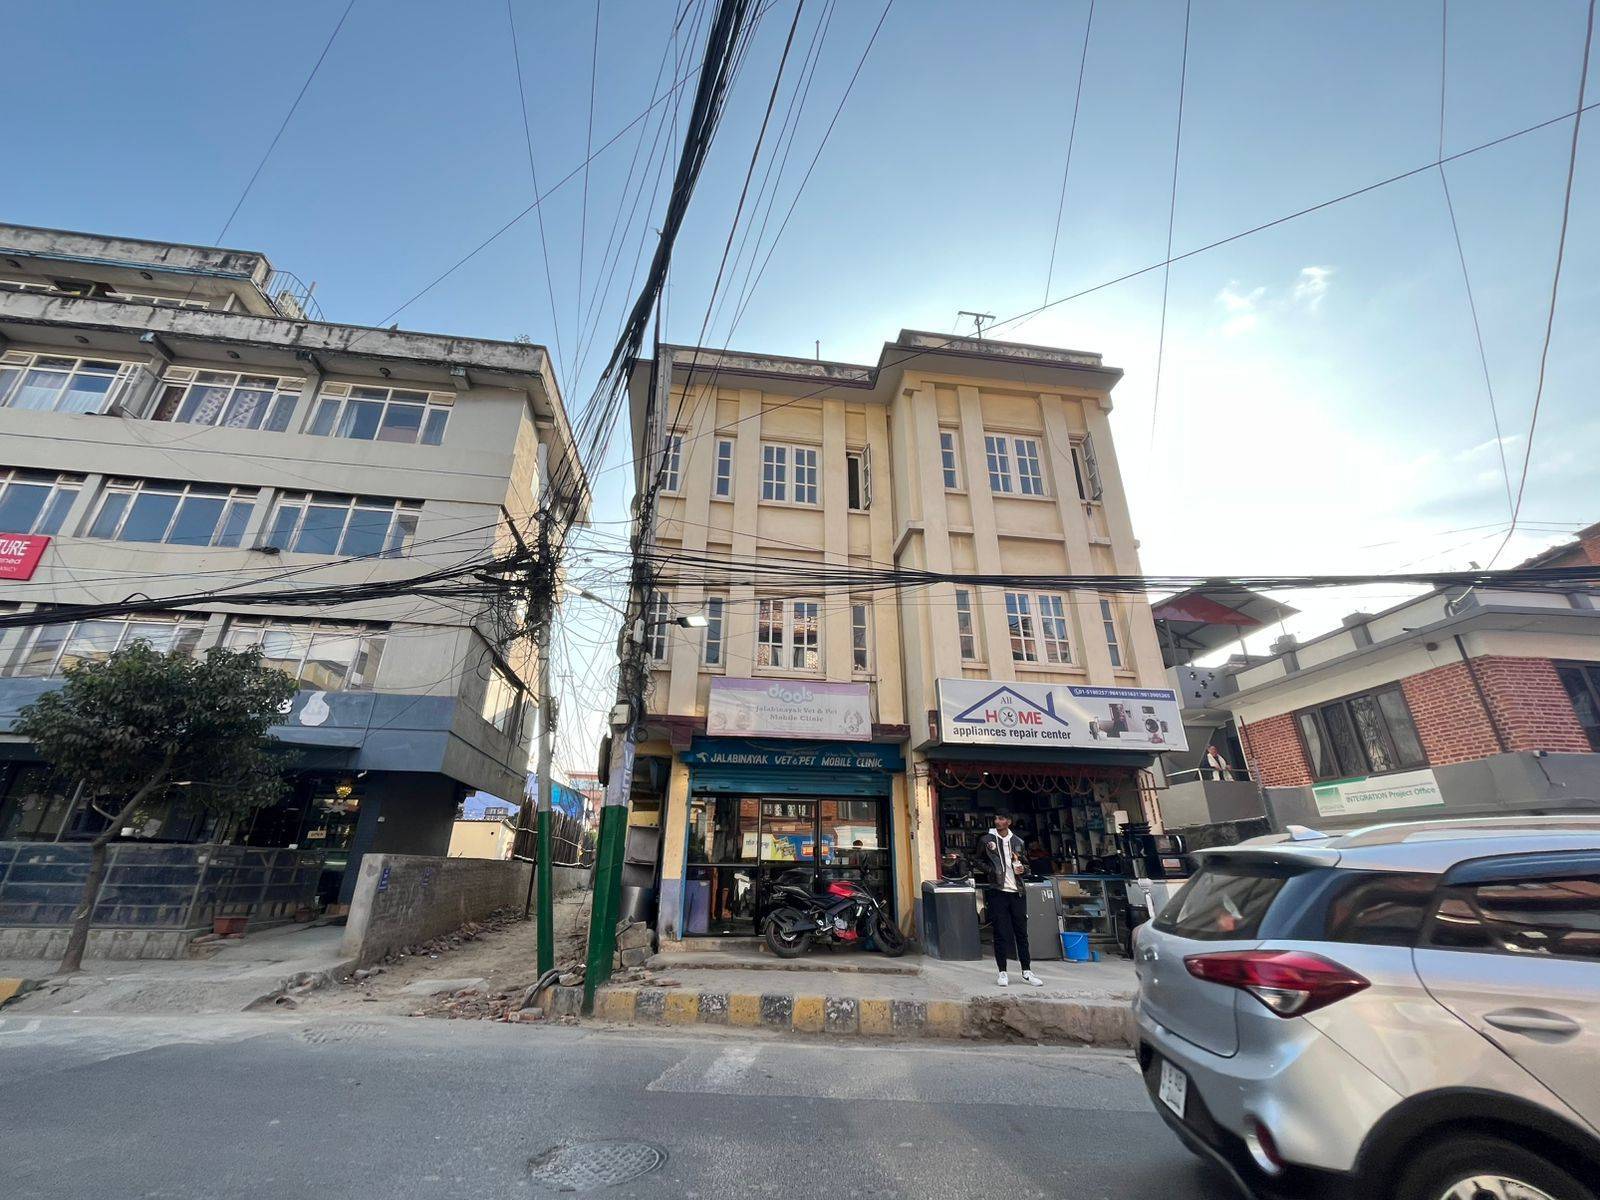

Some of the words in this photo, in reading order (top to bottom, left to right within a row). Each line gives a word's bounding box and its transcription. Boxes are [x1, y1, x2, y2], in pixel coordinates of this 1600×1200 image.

[768, 684, 813, 705] drools
[953, 726, 1007, 738] appliances
[1009, 729, 1038, 740] repair
[1041, 730, 1072, 740] center
[710, 752, 768, 765] JALABINAYAK
[821, 756, 852, 768] MOBILE
[856, 757, 883, 769] CLINIC
[1346, 791, 1389, 804] INTEGRATION
[1389, 789, 1413, 801] Project
[1414, 787, 1436, 797] Office
